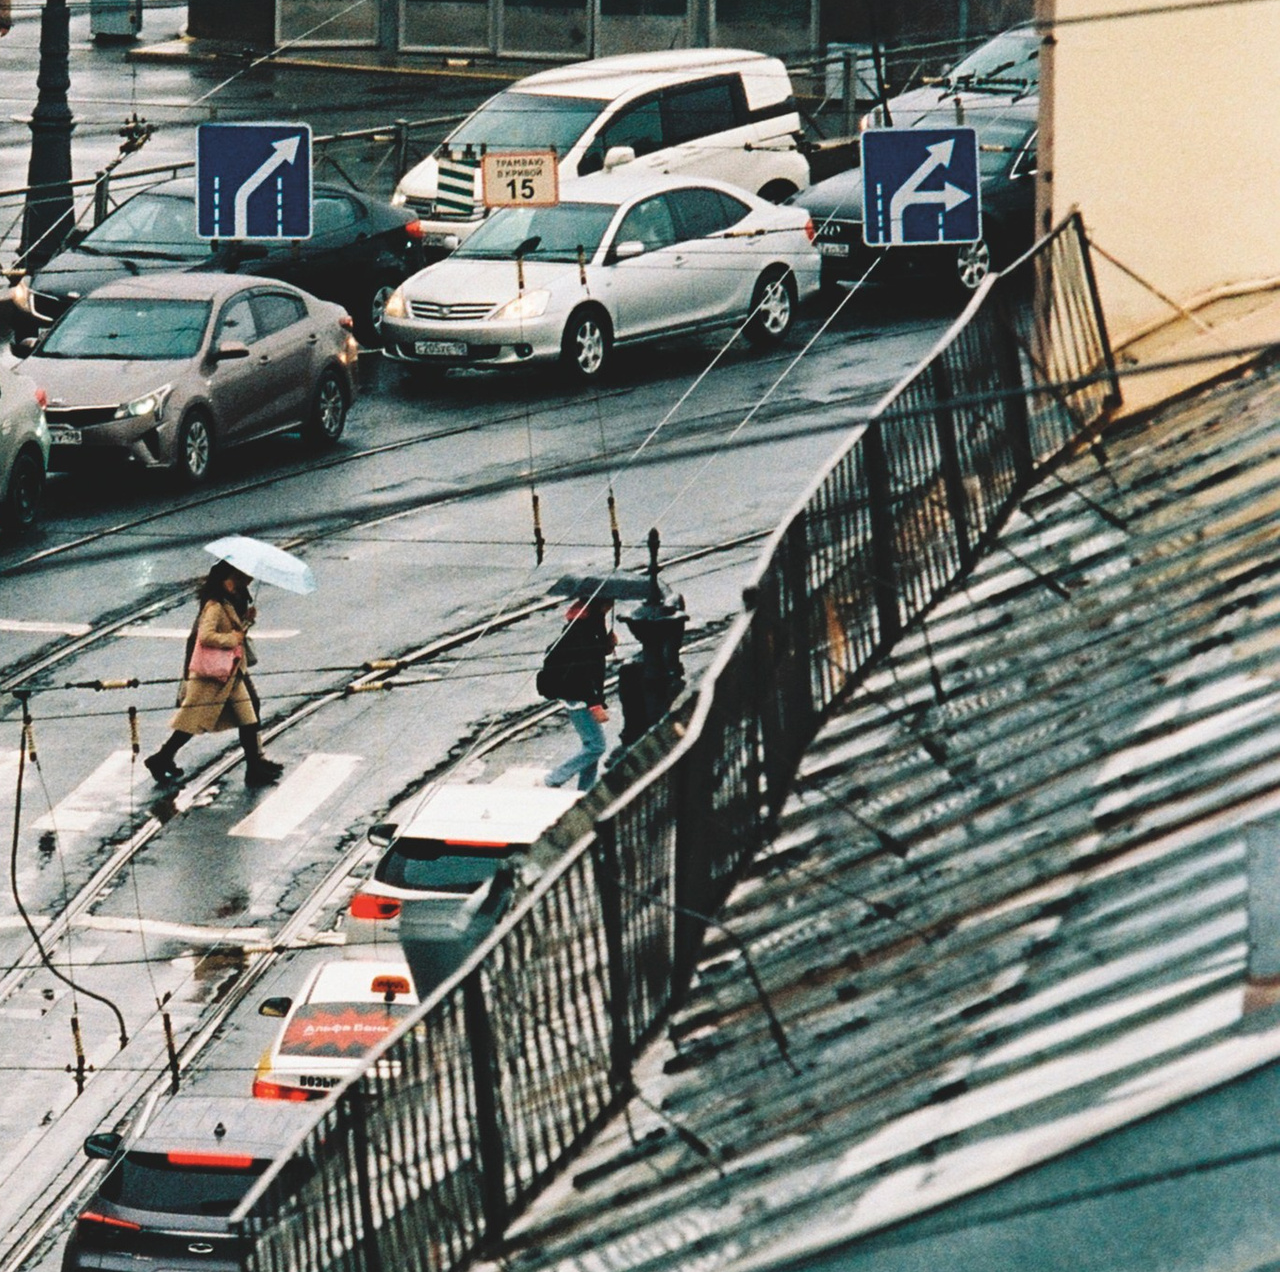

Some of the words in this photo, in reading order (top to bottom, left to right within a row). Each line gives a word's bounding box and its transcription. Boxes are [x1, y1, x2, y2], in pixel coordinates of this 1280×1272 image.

[496, 158, 544, 168] ТРАМВАЮ
[497, 170, 503, 179] В
[505, 168, 543, 178] КРИВОЙ
[506, 178, 535, 200] 15
[303, 1024, 351, 1036] Альфа
[353, 1023, 389, 1033] Банк
